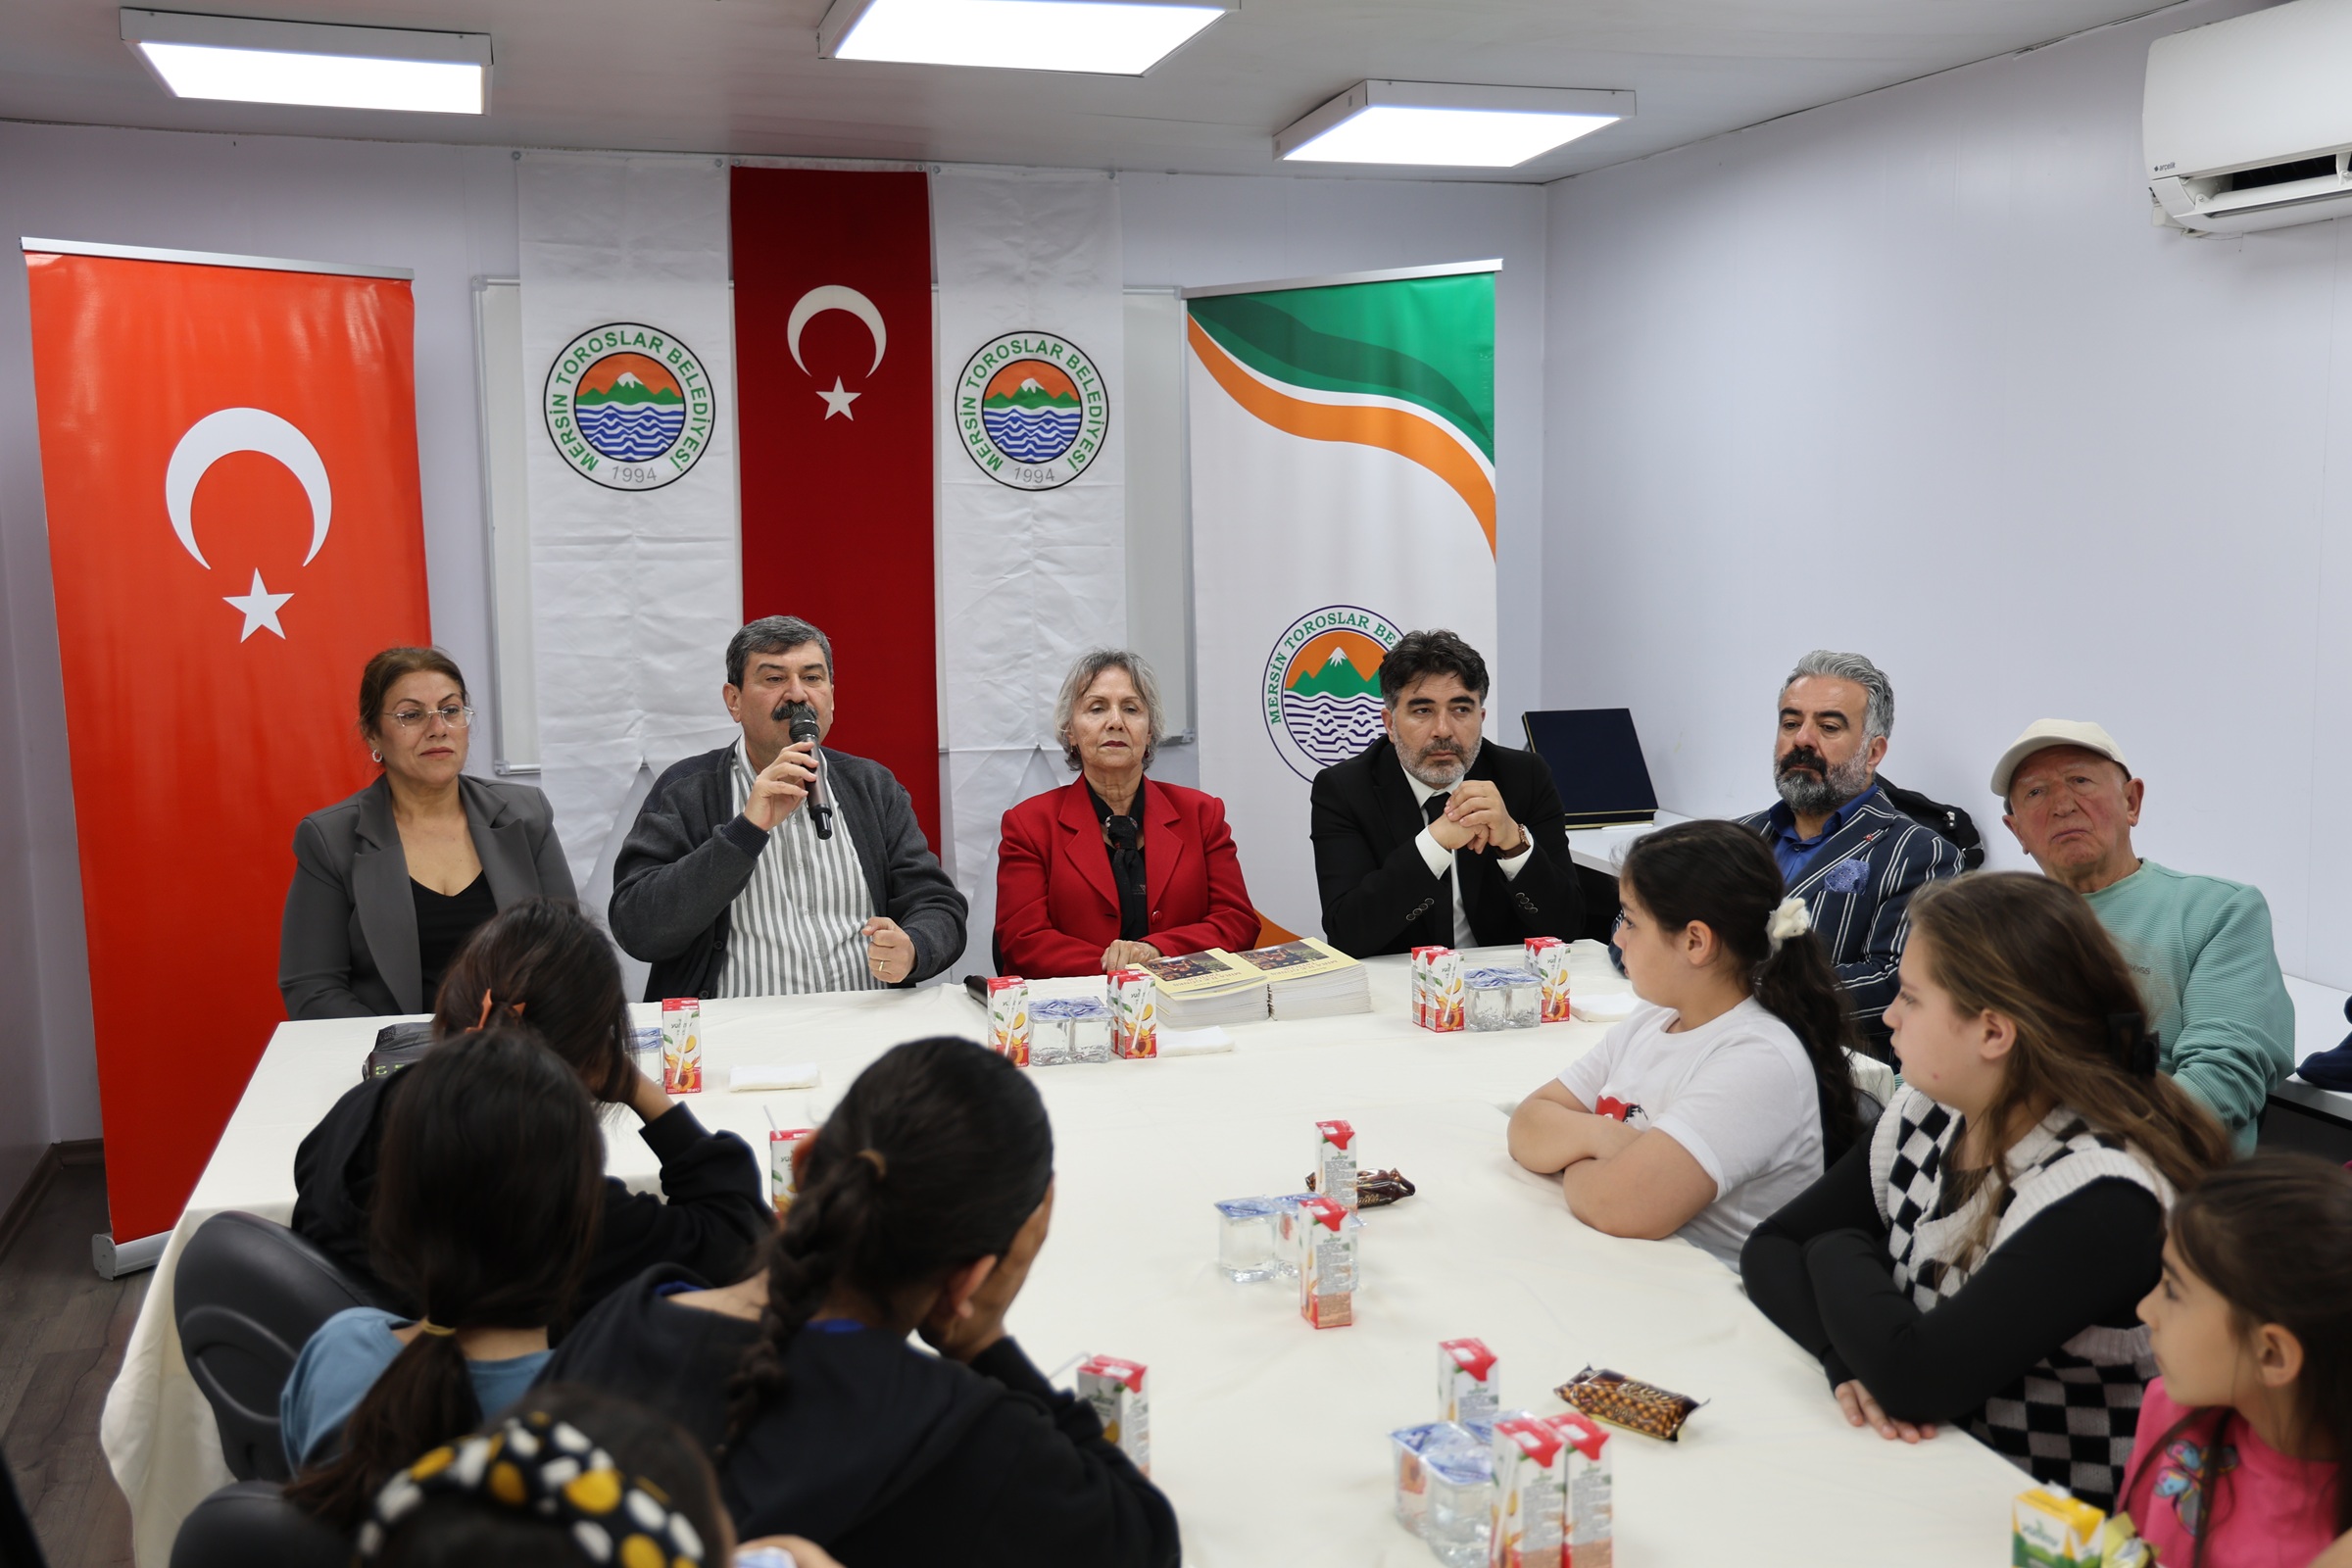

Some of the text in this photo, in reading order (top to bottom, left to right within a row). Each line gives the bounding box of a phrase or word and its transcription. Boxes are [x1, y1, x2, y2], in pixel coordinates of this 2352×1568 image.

[549, 330, 710, 471] MERSİN TOROSLAR BELEDİYESİ
[959, 338, 1105, 472] MERSİN TOROSLAR BELEDİYESİ
[612, 466, 657, 483] 1994
[1014, 466, 1055, 484] 1994
[1266, 651, 1288, 725] MERSİN
[1284, 612, 1370, 651] TOROSLAR
